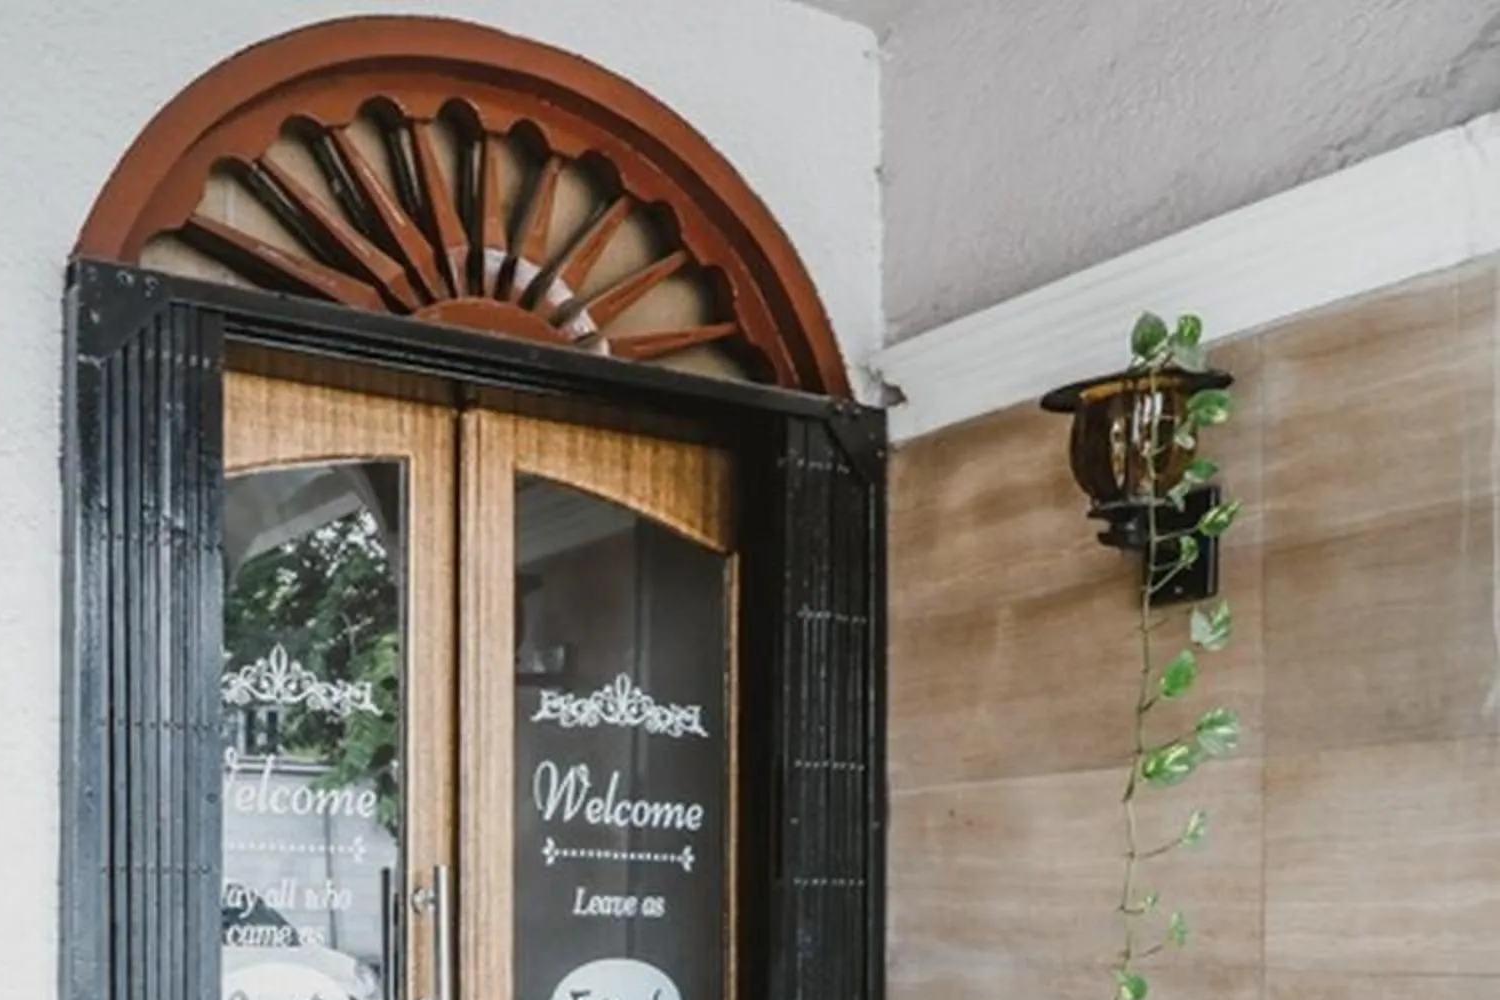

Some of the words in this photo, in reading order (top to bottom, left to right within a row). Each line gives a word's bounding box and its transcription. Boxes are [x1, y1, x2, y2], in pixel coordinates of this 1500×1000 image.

[224, 746, 377, 818] elcome
[532, 759, 705, 832] Welcome
[222, 882, 258, 918] ay
[572, 886, 638, 917] Leave
[640, 896, 666, 917] as
